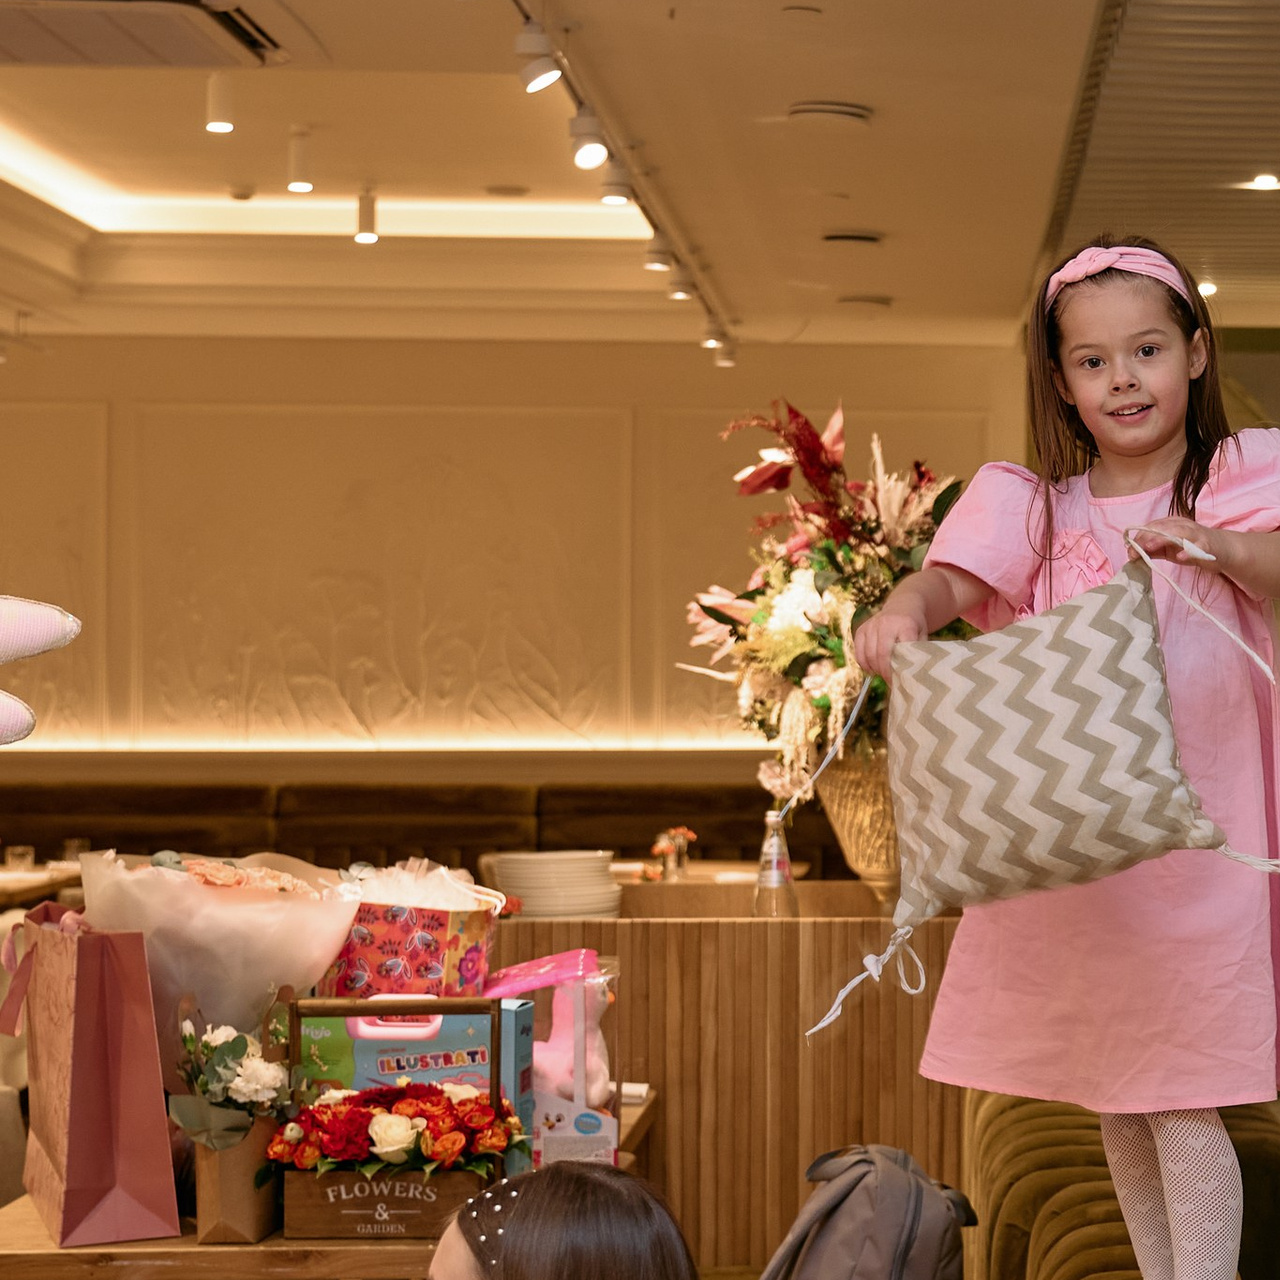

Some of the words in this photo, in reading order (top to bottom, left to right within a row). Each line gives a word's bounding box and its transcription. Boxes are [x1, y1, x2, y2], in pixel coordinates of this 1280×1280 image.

[377, 1045, 489, 1075] ILLUSTRATI
[326, 1181, 438, 1203] FLOWERS
[375, 1203, 390, 1221] &
[357, 1223, 406, 1234] GARDEN
